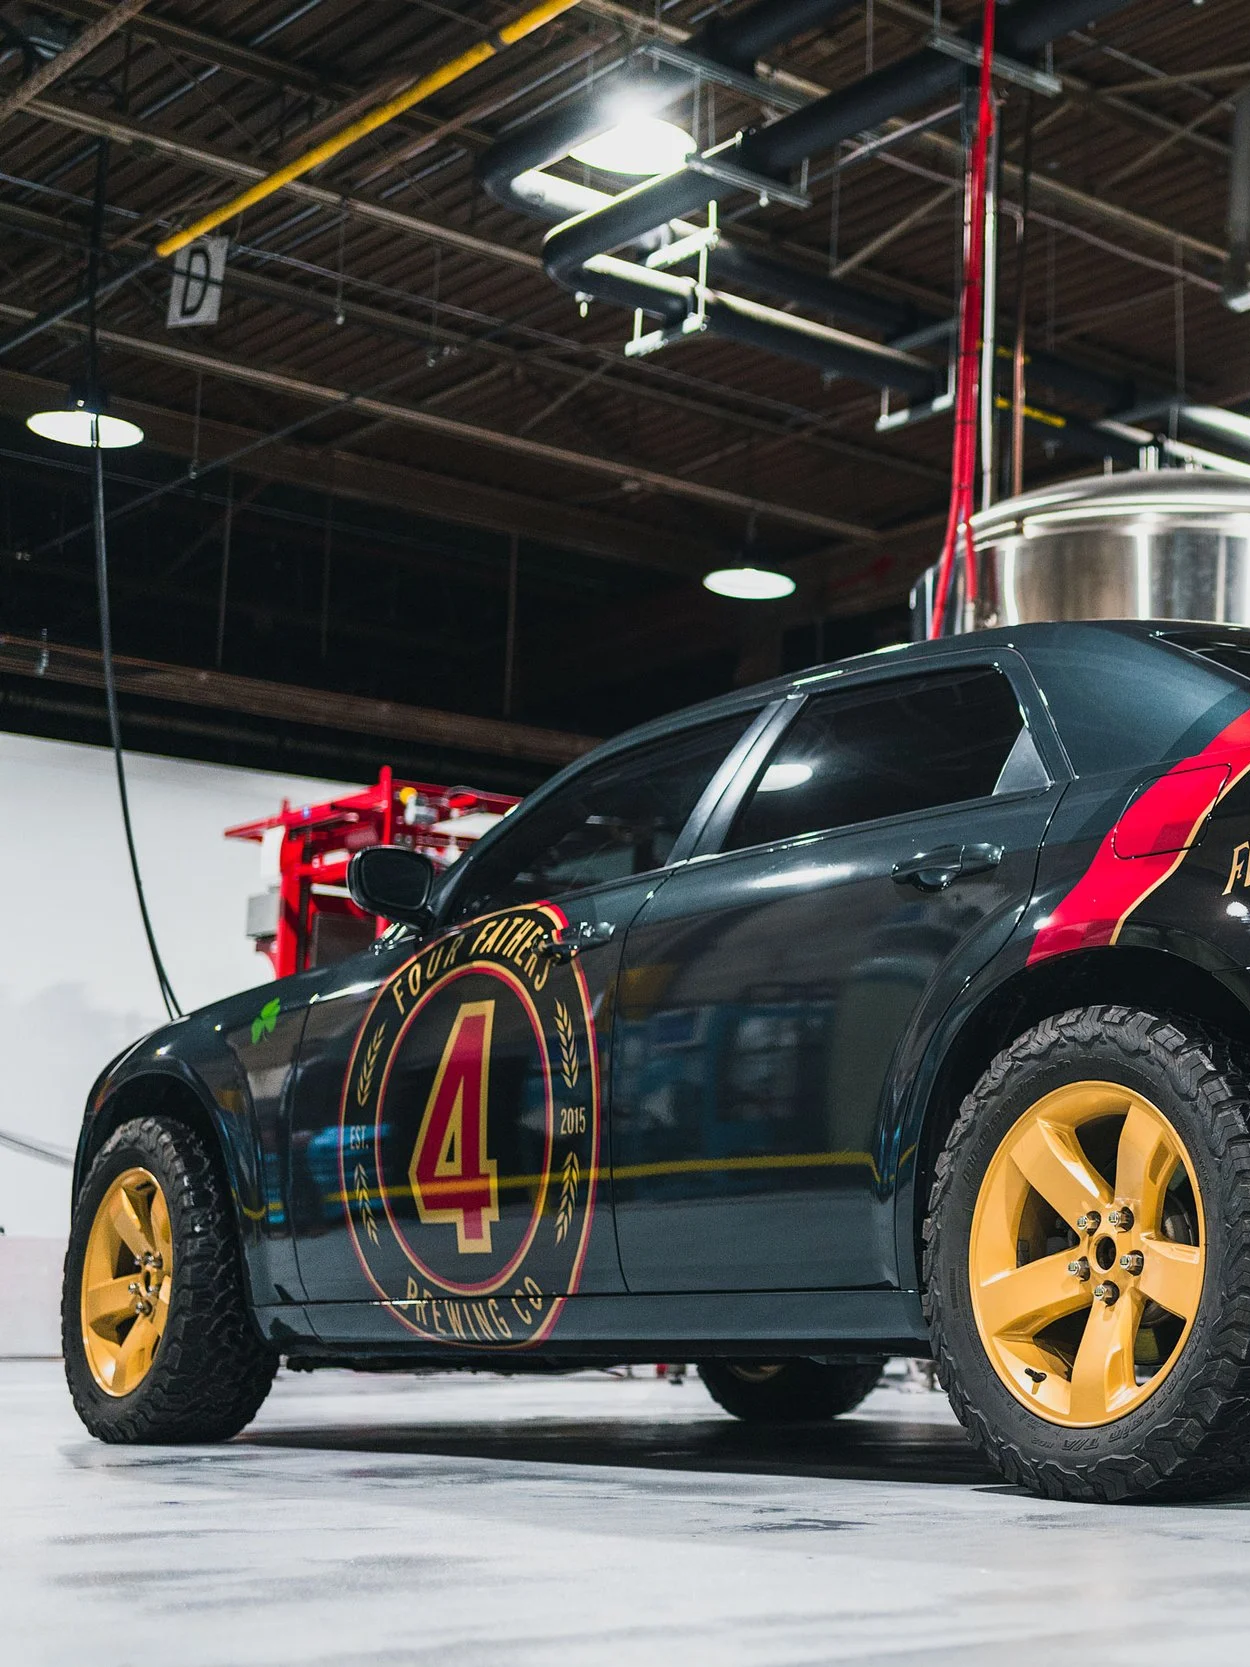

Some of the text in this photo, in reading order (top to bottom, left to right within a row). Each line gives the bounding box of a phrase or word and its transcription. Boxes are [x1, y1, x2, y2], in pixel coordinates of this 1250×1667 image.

[181, 247, 210, 317] D
[393, 916, 560, 1016] FOUR FATHERS
[350, 1125, 369, 1150] EST.
[408, 999, 500, 1254] 4
[560, 1106, 586, 1135] 2015
[401, 1275, 543, 1342] BREWING CO
